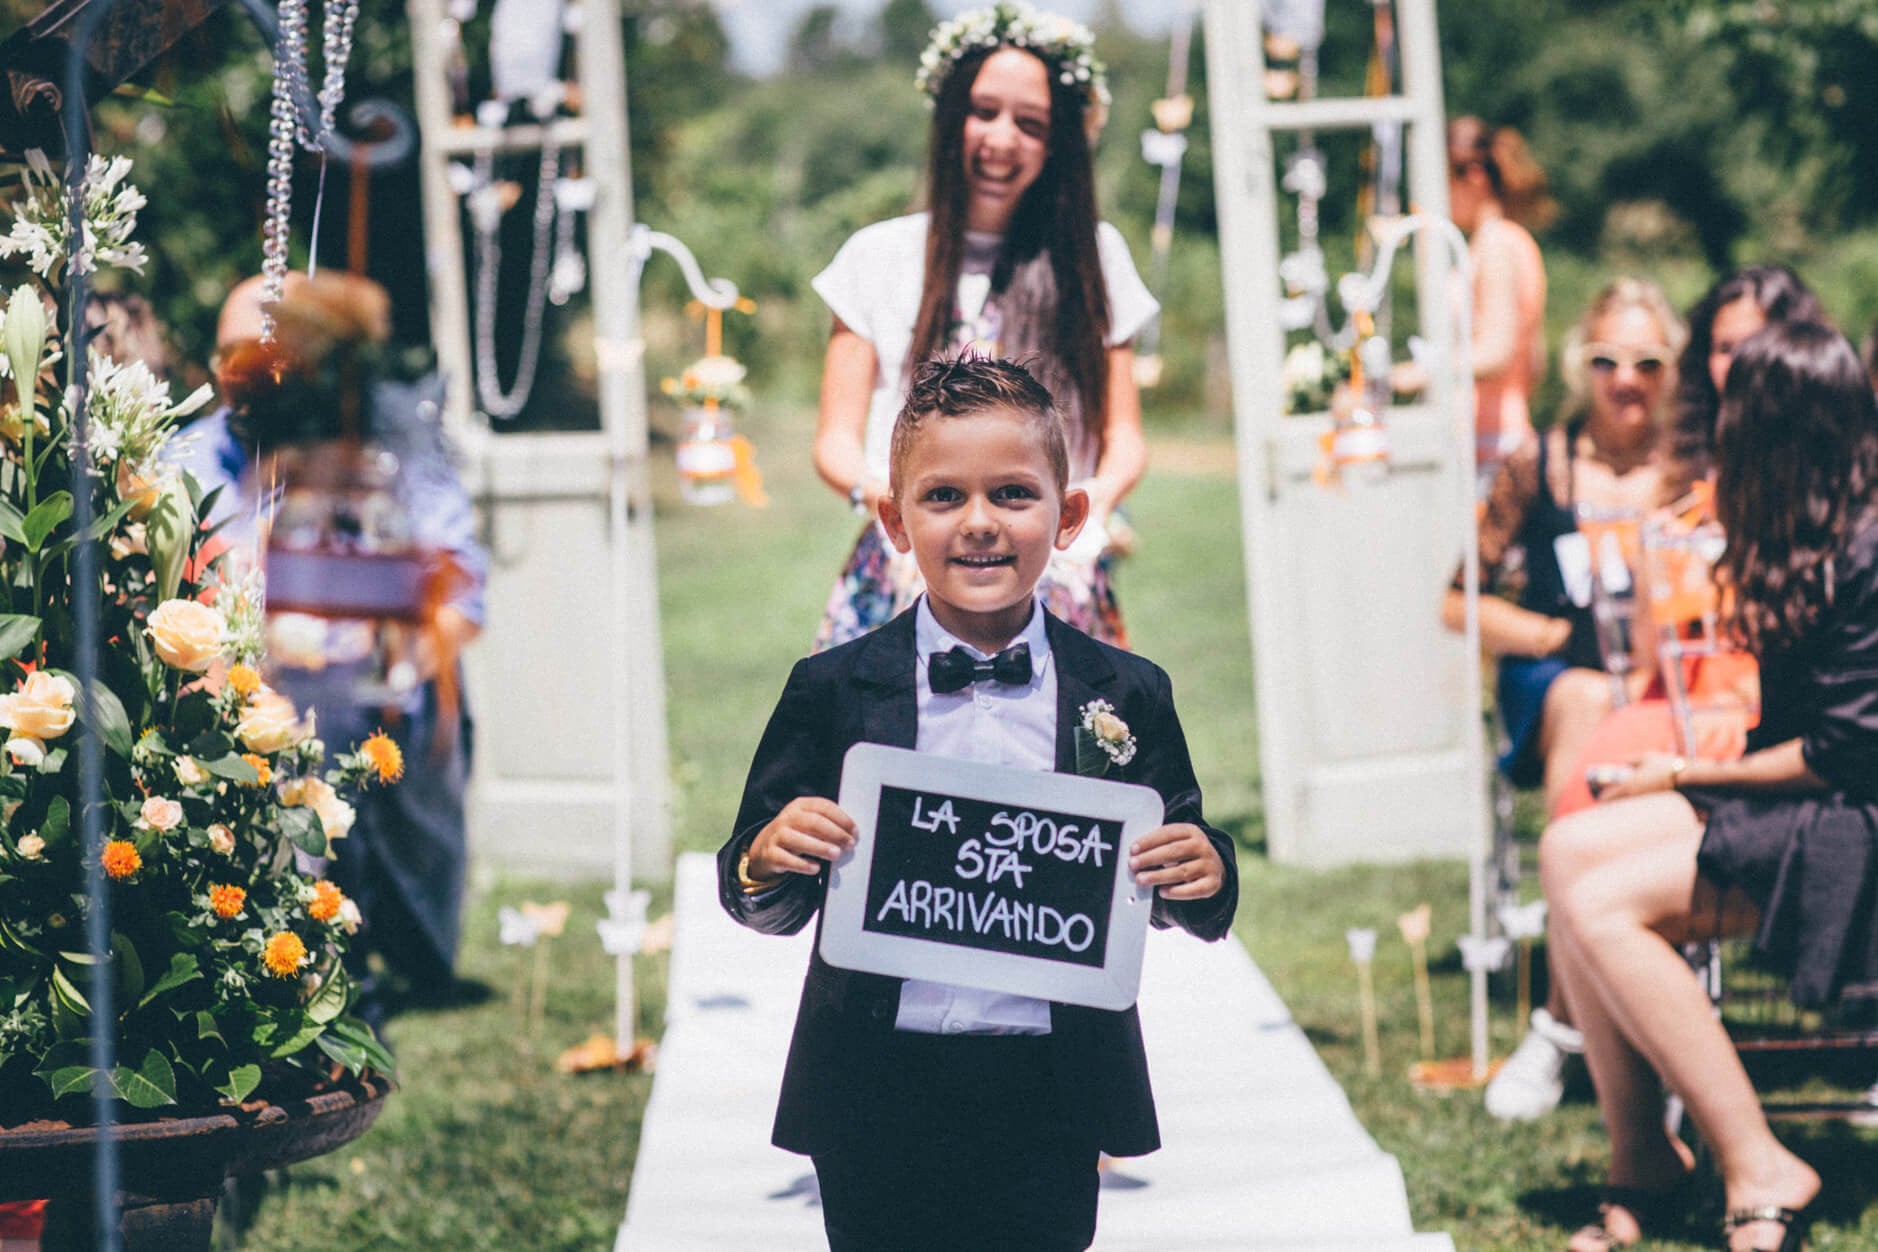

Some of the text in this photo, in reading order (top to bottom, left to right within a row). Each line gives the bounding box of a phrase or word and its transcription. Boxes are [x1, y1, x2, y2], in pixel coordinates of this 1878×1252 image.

[911, 796, 1112, 867] LA SPOSA
[955, 838, 1033, 889] STA
[877, 879, 1095, 953] ARRIVANDO
